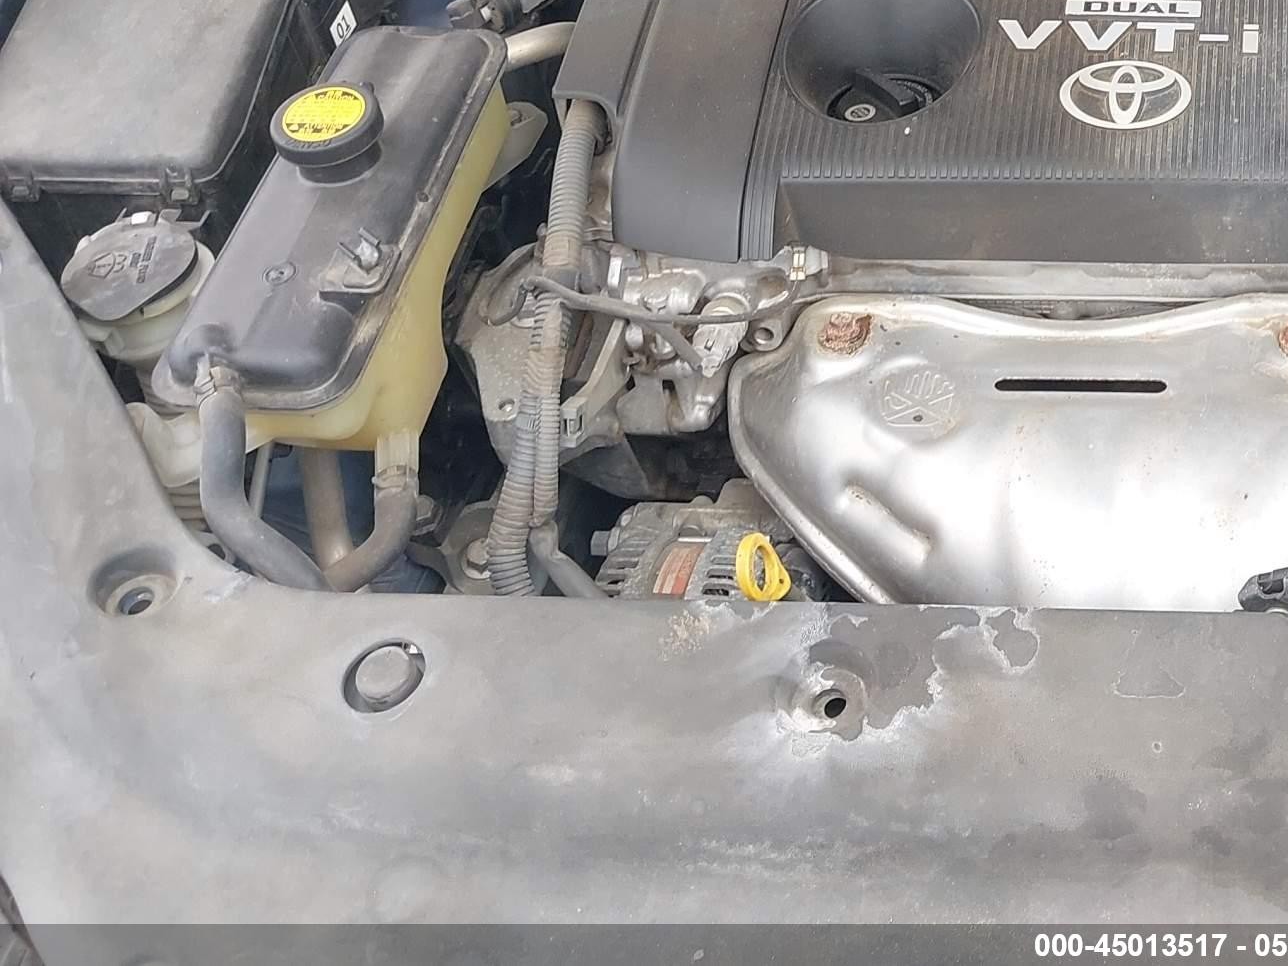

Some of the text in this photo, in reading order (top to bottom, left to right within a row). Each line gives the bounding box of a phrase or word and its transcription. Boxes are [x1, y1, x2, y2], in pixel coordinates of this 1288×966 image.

[1083, 0, 1190, 14] DUAL
[336, 14, 350, 39] 01
[998, 19, 1260, 54] VVT-i
